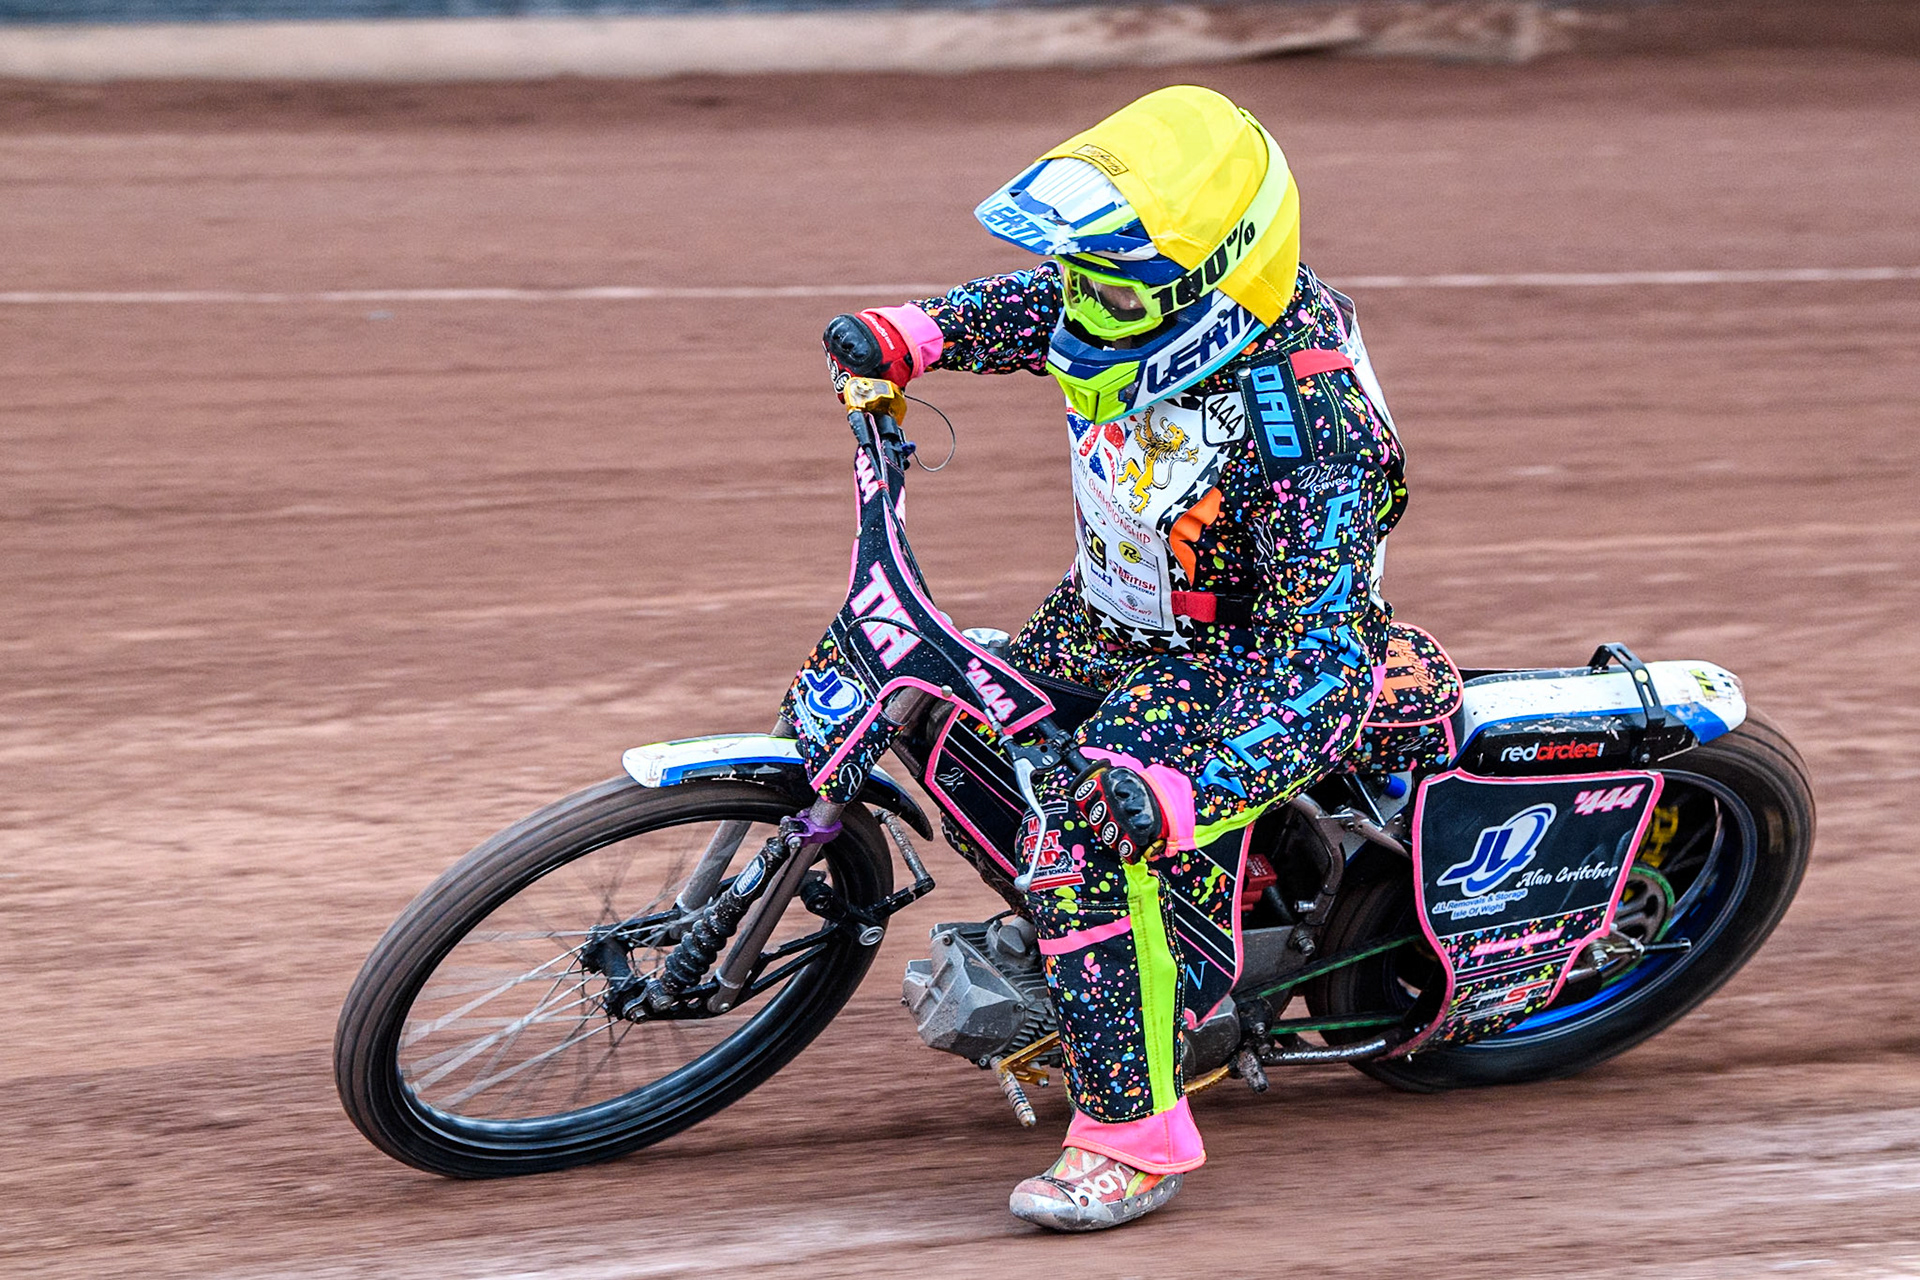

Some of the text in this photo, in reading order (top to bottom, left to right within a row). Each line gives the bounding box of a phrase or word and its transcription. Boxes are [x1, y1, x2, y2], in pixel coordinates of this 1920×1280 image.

[1151, 218, 1256, 316] 100%
[1207, 395, 1244, 439] 444
[1250, 365, 1302, 458] DAD
[1112, 494, 1142, 529] 2024
[1516, 868, 1552, 888] Alan
